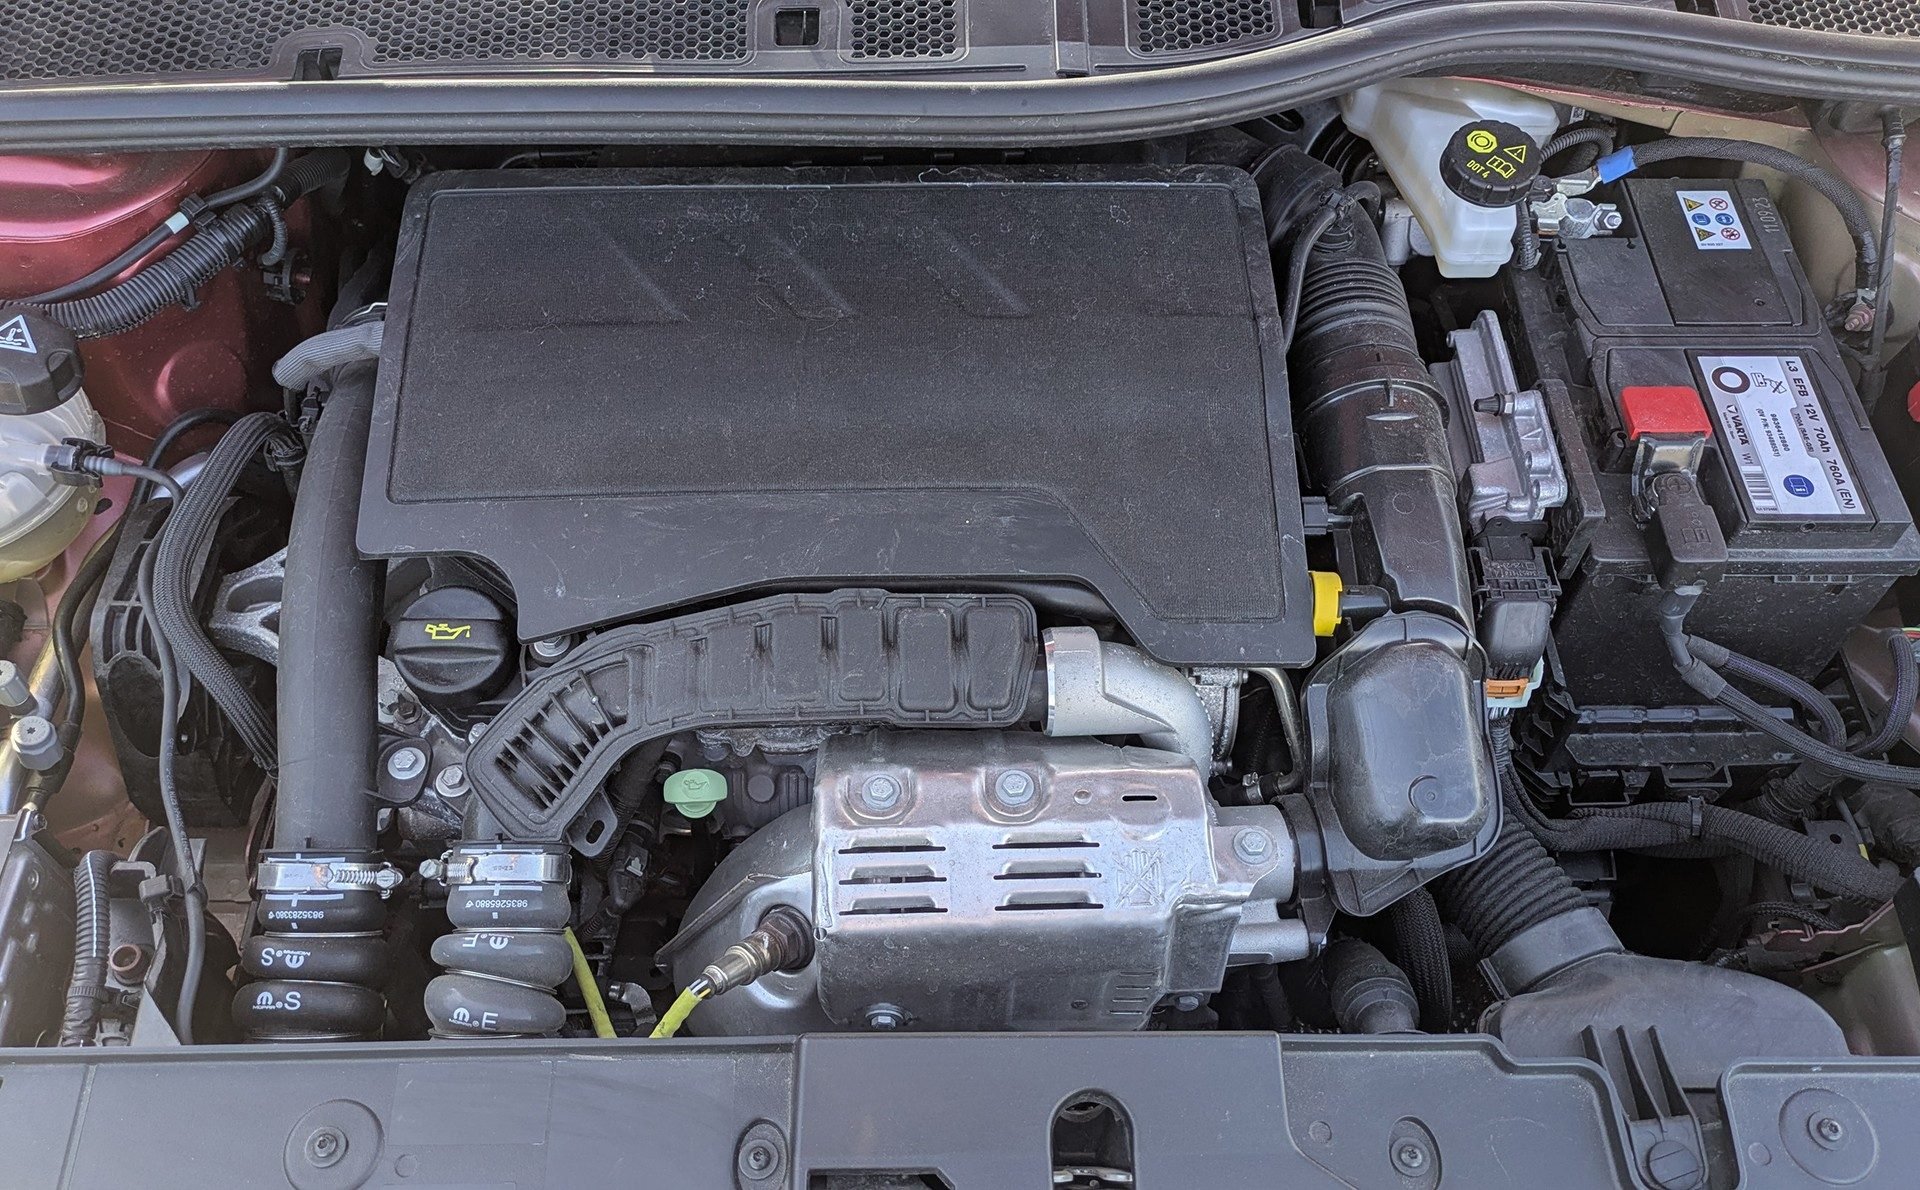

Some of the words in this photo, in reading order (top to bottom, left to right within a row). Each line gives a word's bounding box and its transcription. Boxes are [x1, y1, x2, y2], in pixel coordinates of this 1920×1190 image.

[1466, 159, 1486, 174] DOT
[1482, 170, 1491, 179] 4
[1729, 415, 1749, 446] VARTA
[1785, 360, 1799, 372] L3
[1792, 377, 1809, 397] EFB
[1803, 403, 1819, 422] 12V
[1813, 427, 1832, 453] 70Ah
[1826, 459, 1846, 486] 760A
[1836, 488, 1856, 510] (EN)
[475, 899, 528, 908] 9835265880
[261, 947, 275, 966] S
[283, 991, 301, 1011] S
[481, 1011, 499, 1031] E
